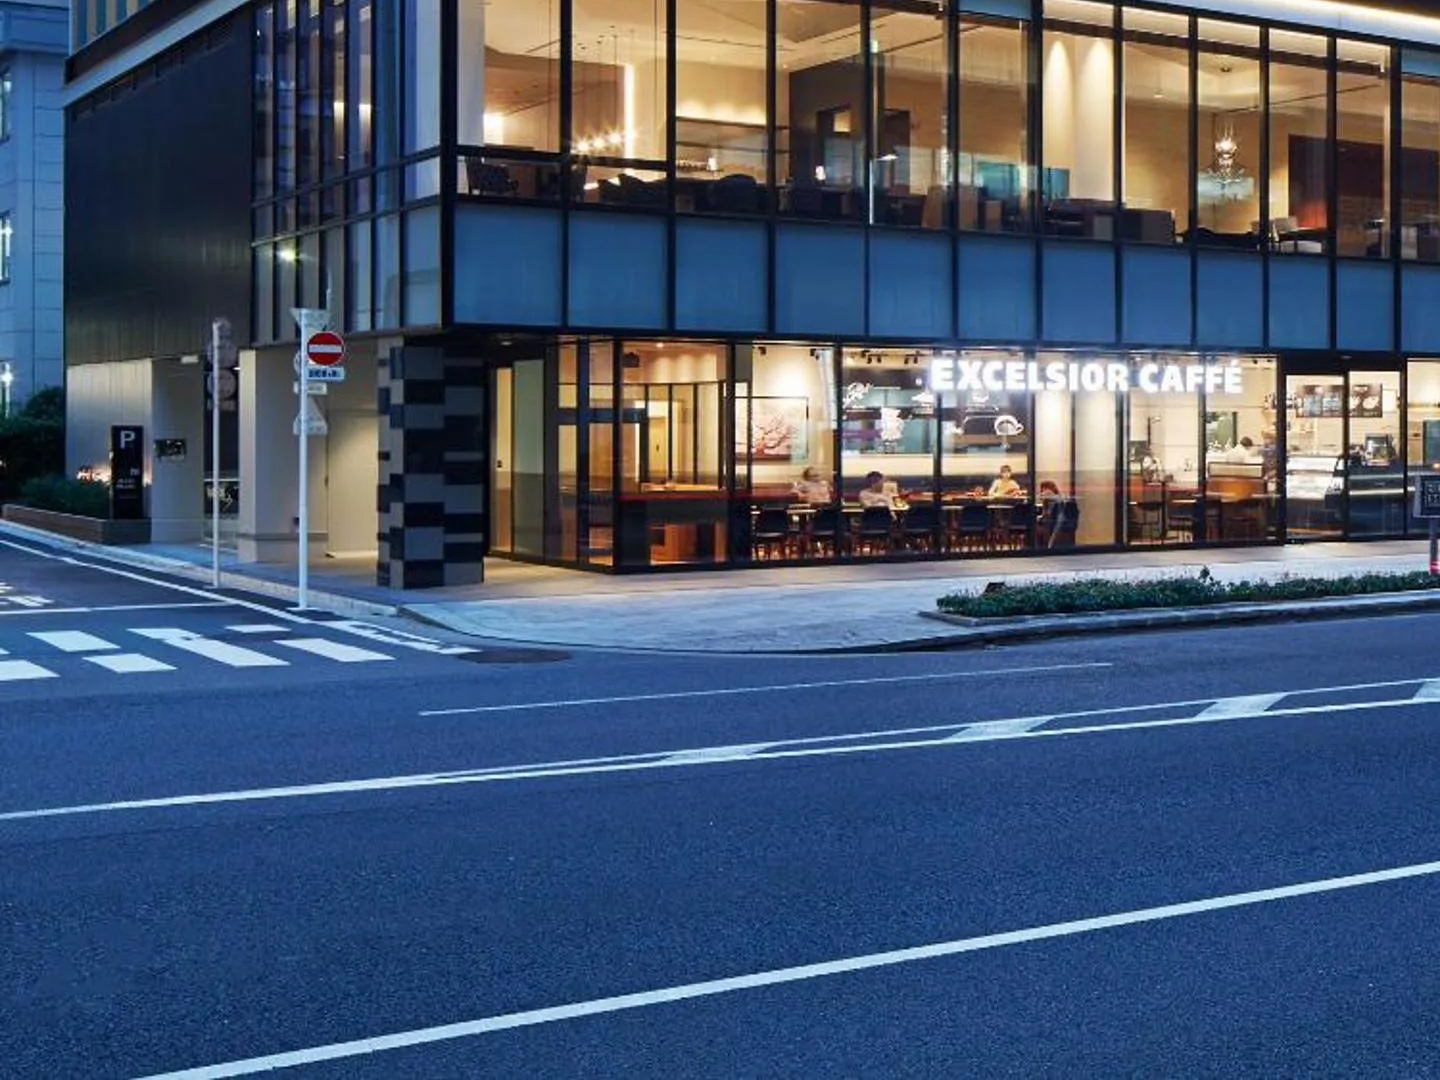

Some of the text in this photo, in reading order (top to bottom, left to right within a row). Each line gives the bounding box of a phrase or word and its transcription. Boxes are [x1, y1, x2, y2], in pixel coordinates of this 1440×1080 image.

[930, 358, 1243, 394] EXCELSIOR CAFFÉ
[120, 430, 136, 449] P
